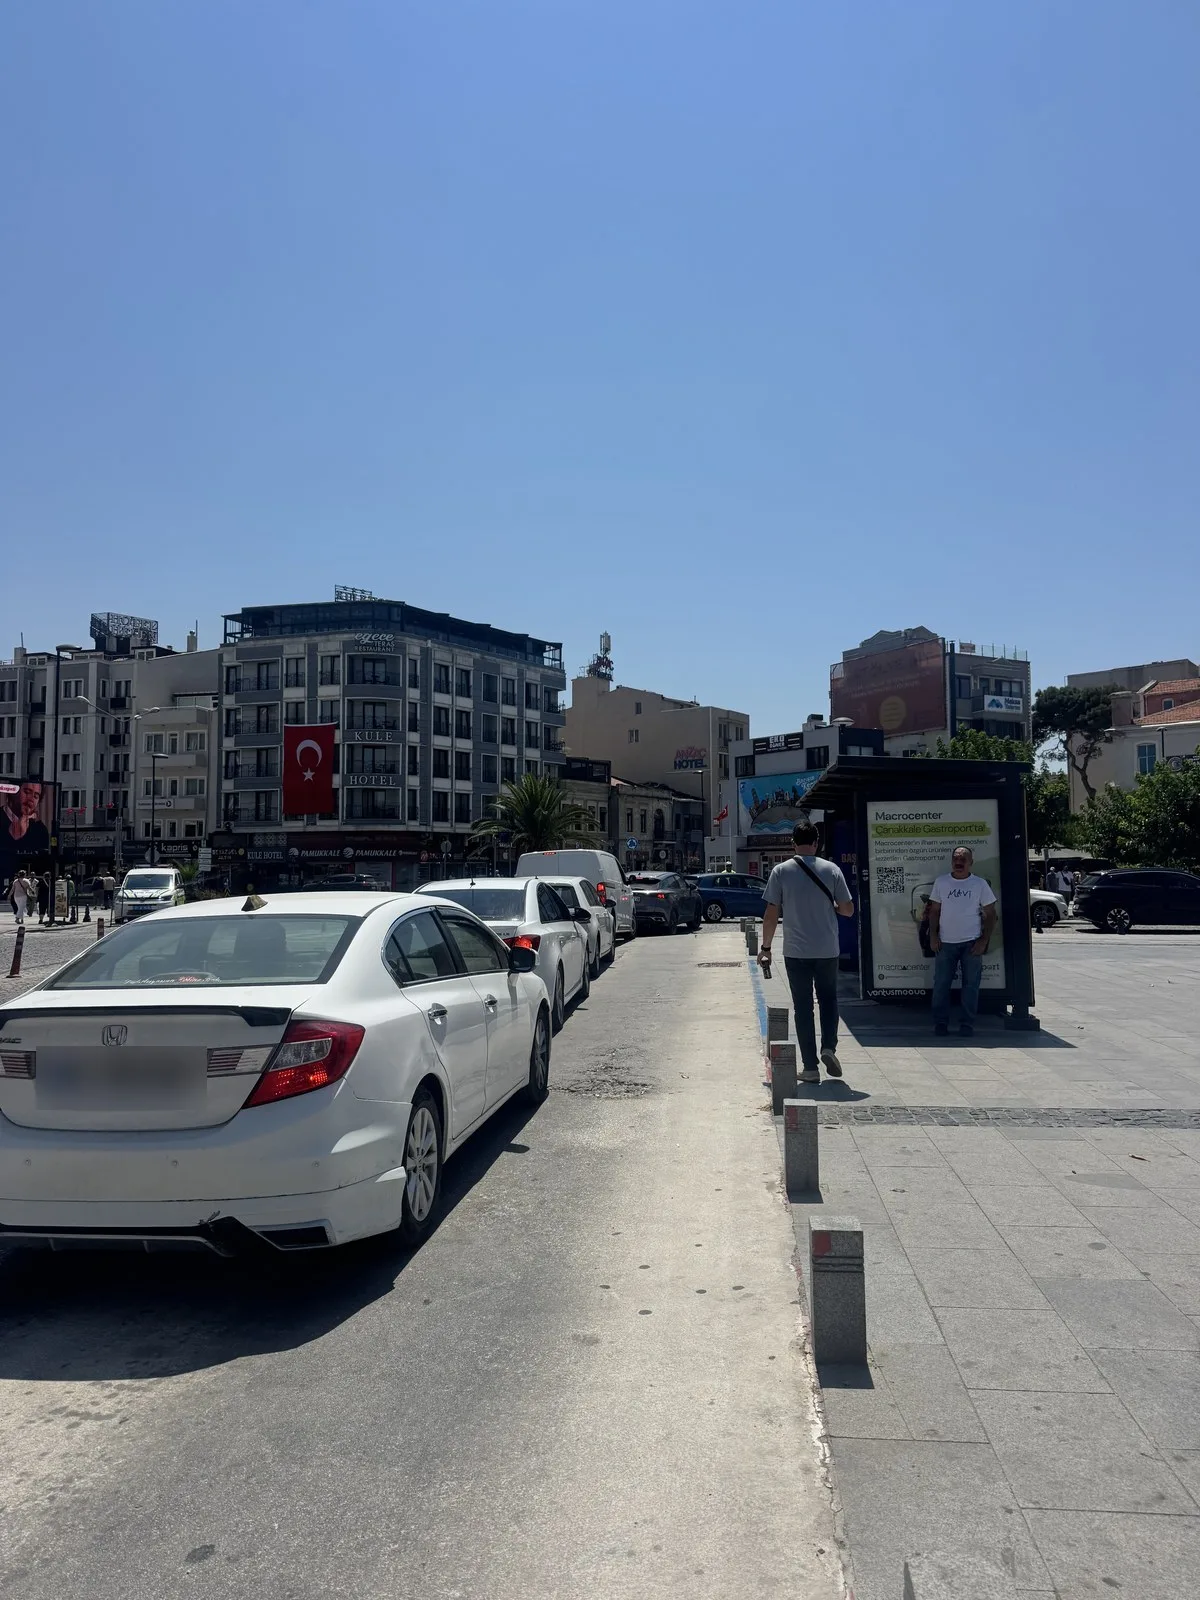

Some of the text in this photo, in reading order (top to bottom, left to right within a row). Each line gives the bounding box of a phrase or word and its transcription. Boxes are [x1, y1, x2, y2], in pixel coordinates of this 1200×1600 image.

[354, 731, 393, 741] KULE
[673, 758, 708, 769] HOTEL
[350, 775, 396, 786] HOTEL
[875, 811, 943, 821] Macrocenter
[875, 824, 985, 835] Çanakkale Gastroport'ta!
[161, 842, 189, 854] kapris
[300, 849, 341, 857] PAMUKKALE
[355, 849, 397, 857] PAMUKKALE
[247, 851, 284, 860] KULE HOTEL
